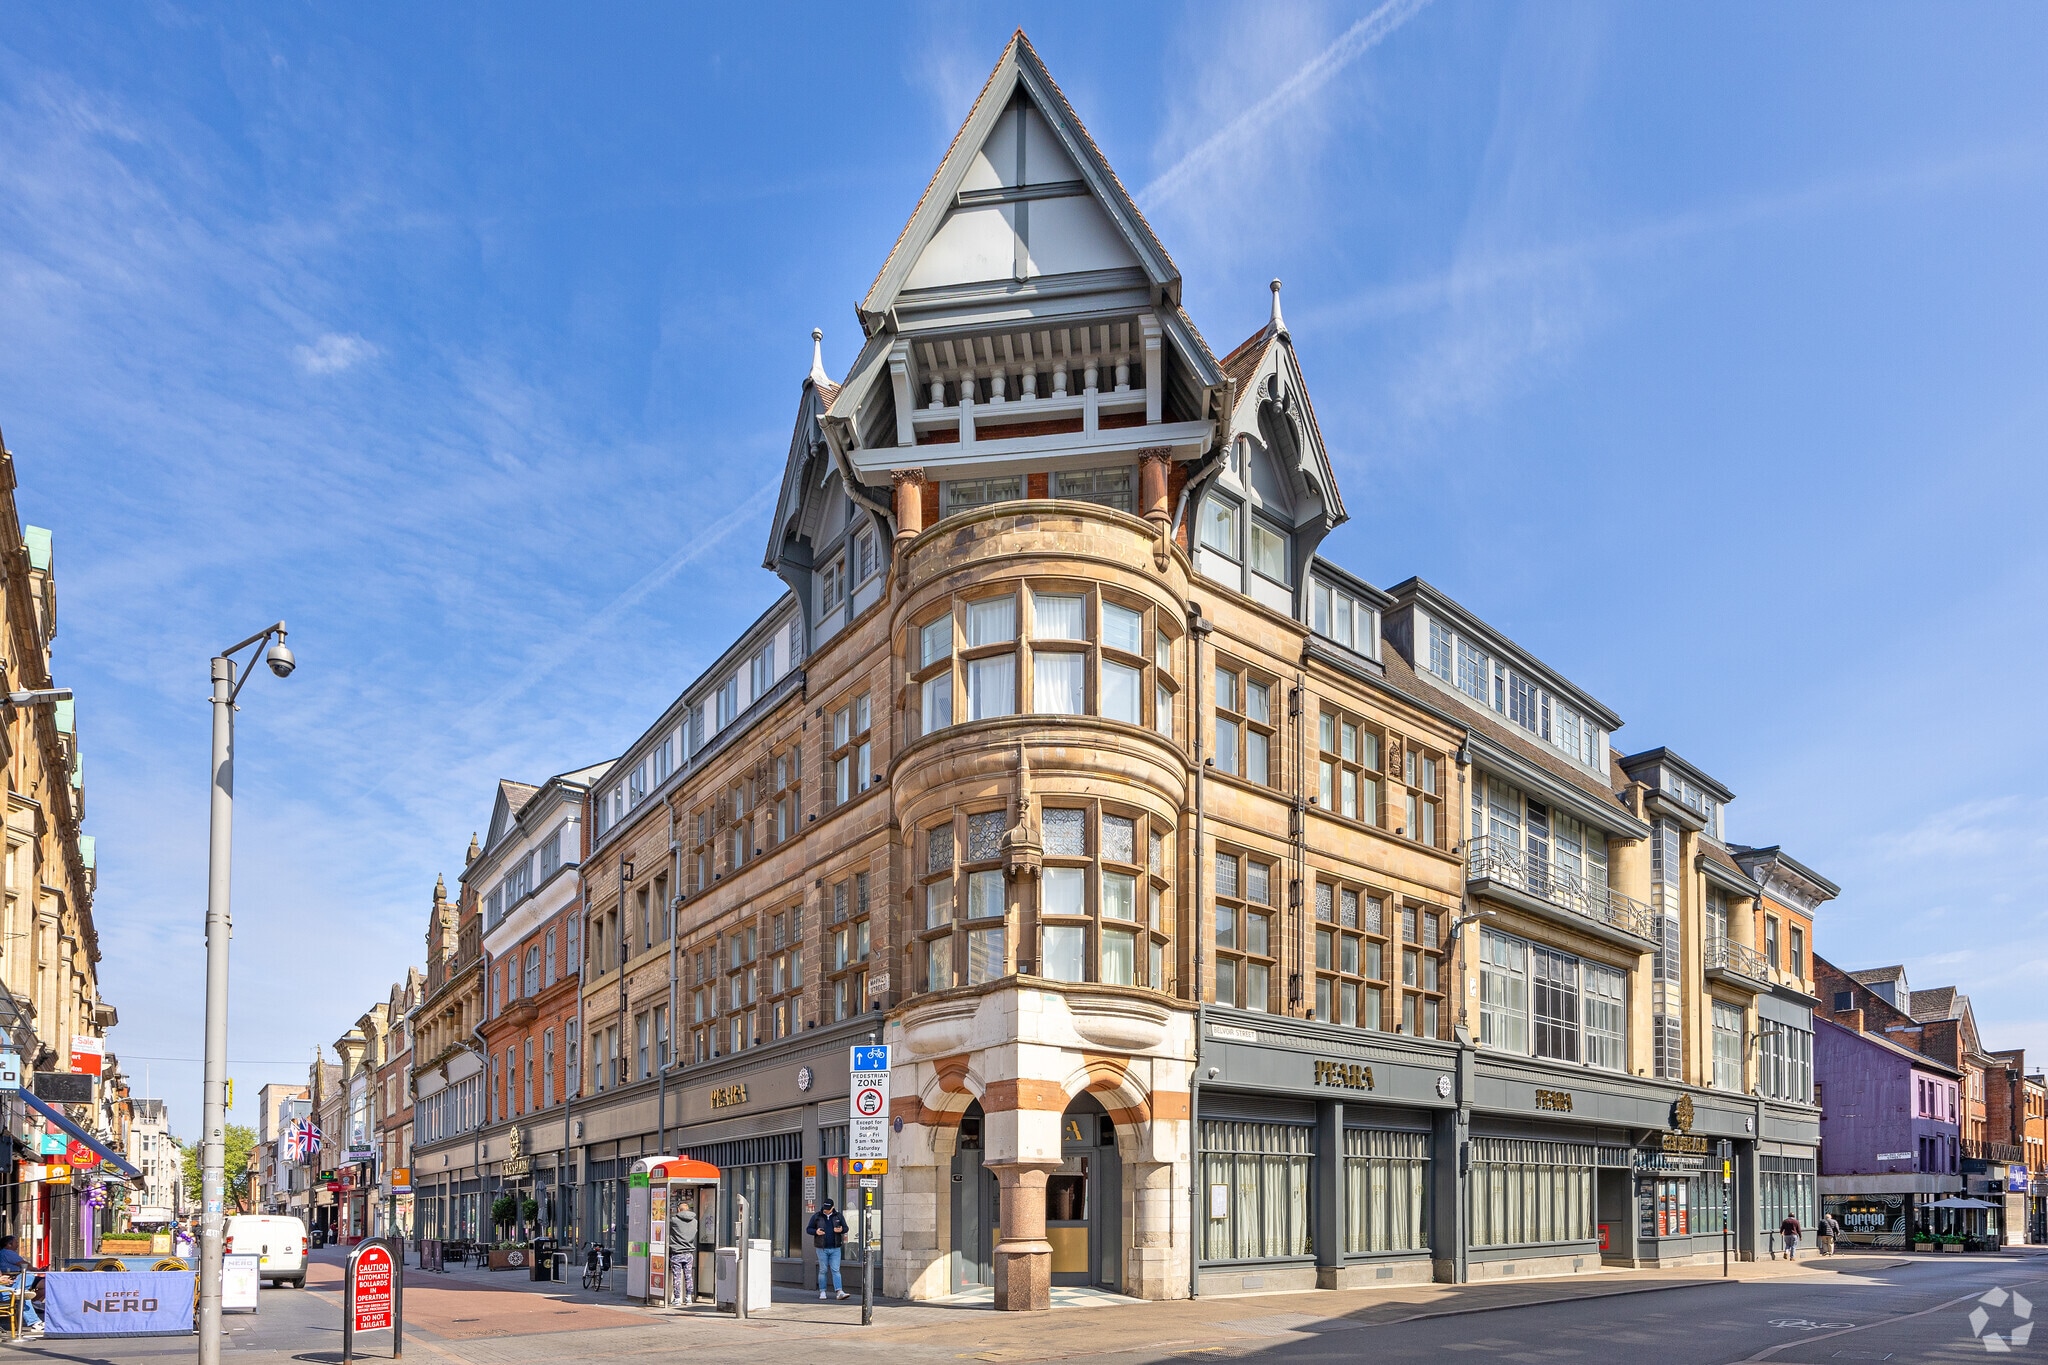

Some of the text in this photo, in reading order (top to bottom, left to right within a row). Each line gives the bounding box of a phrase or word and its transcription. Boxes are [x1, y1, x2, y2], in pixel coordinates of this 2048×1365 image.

[1213, 1026, 1255, 1038] BELVOIR STREET
[78, 1036, 94, 1046] Sale
[1314, 1060, 1374, 1089] PEARA
[358, 1293, 389, 1301] OPERATION
[83, 1299, 158, 1313] NERO
